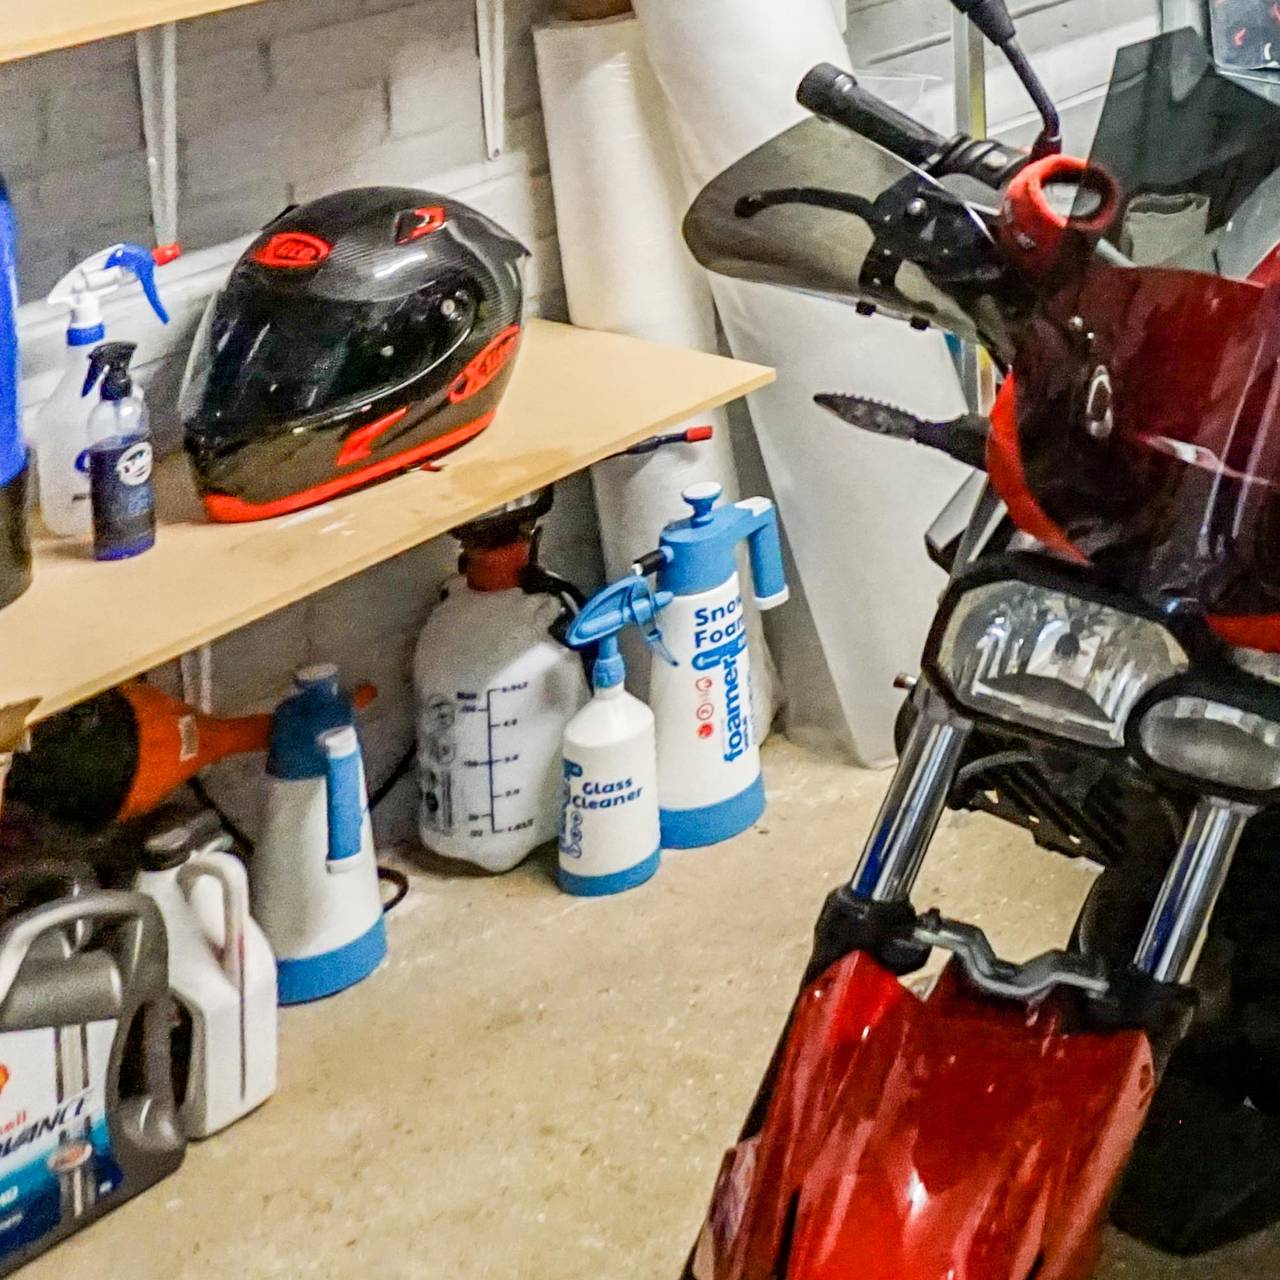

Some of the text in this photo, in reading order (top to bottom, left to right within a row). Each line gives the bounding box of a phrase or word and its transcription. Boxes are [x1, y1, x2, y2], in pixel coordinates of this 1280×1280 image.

[722, 654, 745, 763] foamer
[572, 786, 643, 810] Cleaner
[582, 777, 633, 795] Glass
